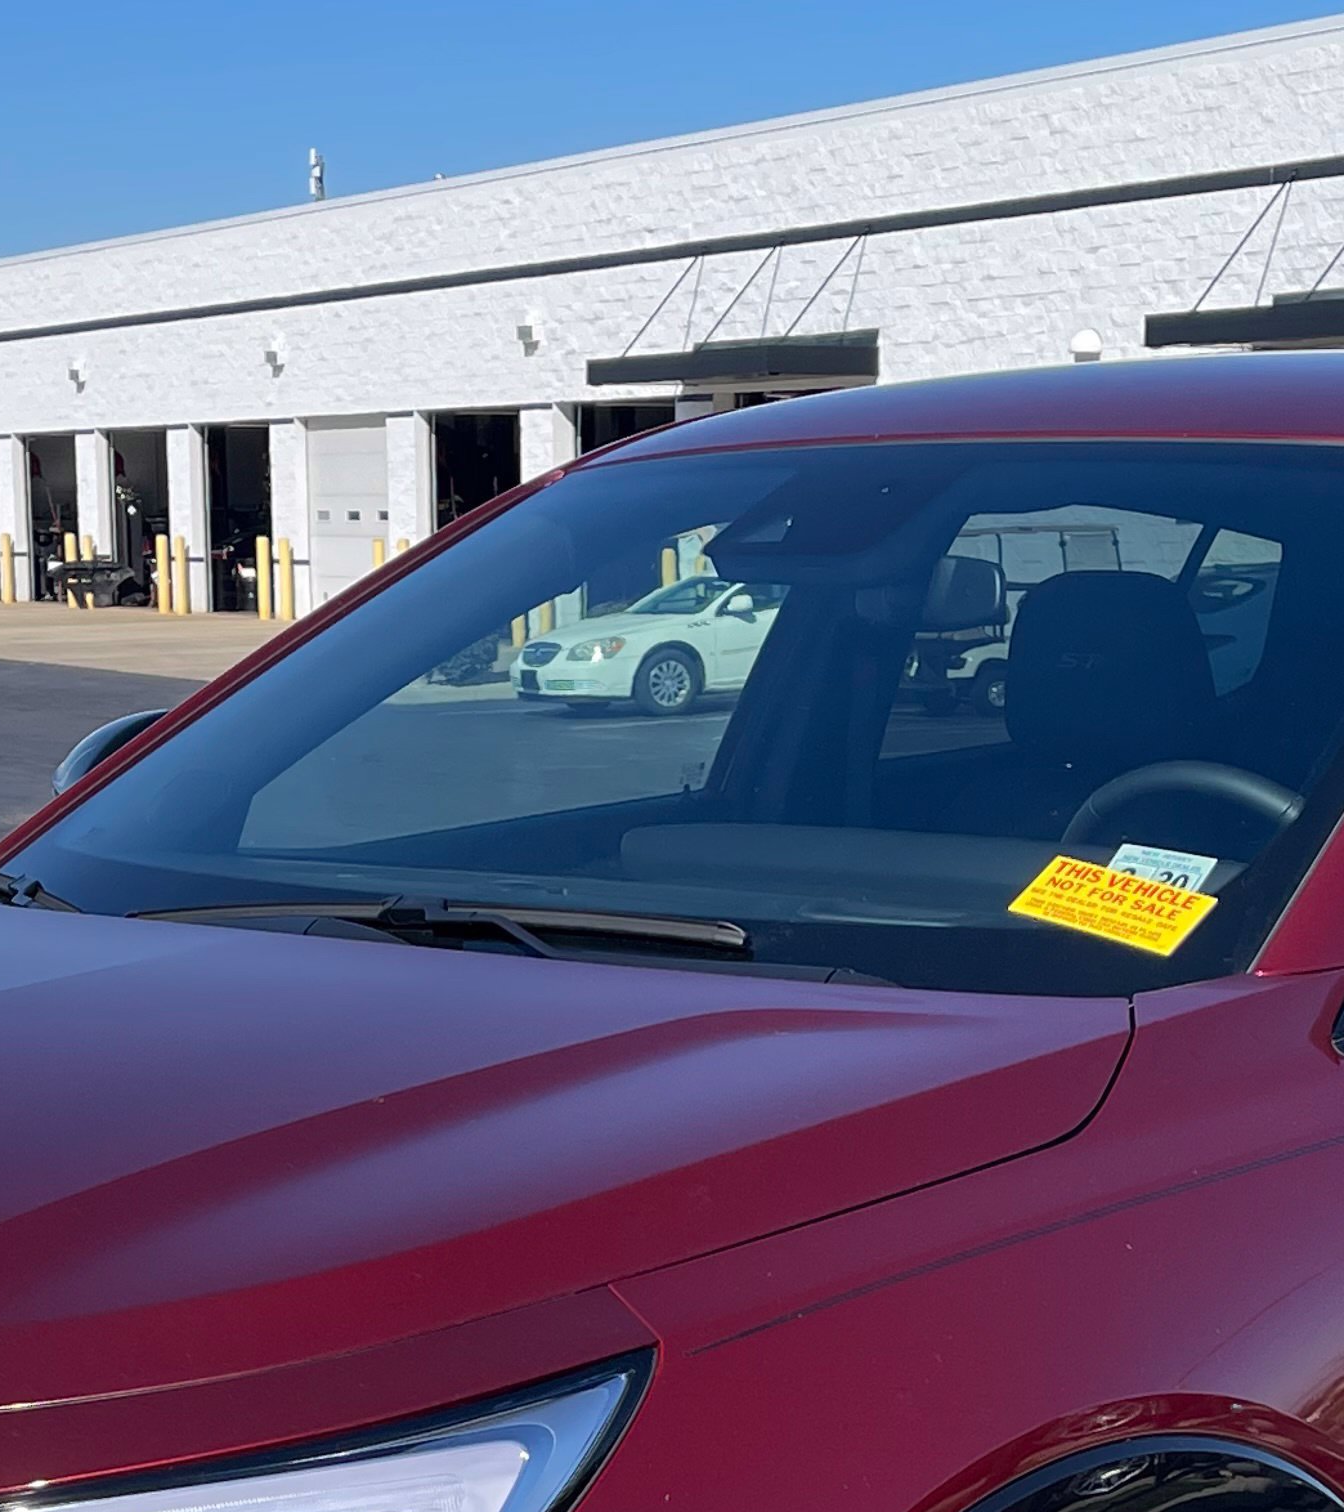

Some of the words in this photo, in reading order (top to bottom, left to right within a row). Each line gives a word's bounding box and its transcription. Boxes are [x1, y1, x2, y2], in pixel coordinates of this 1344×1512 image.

[1045, 876, 1087, 894] NOT
[1087, 886, 1130, 906] FOR
[1130, 899, 1183, 921] SALE
[1054, 860, 1105, 883] THIS
[1108, 872, 1201, 911] VEHICLE
